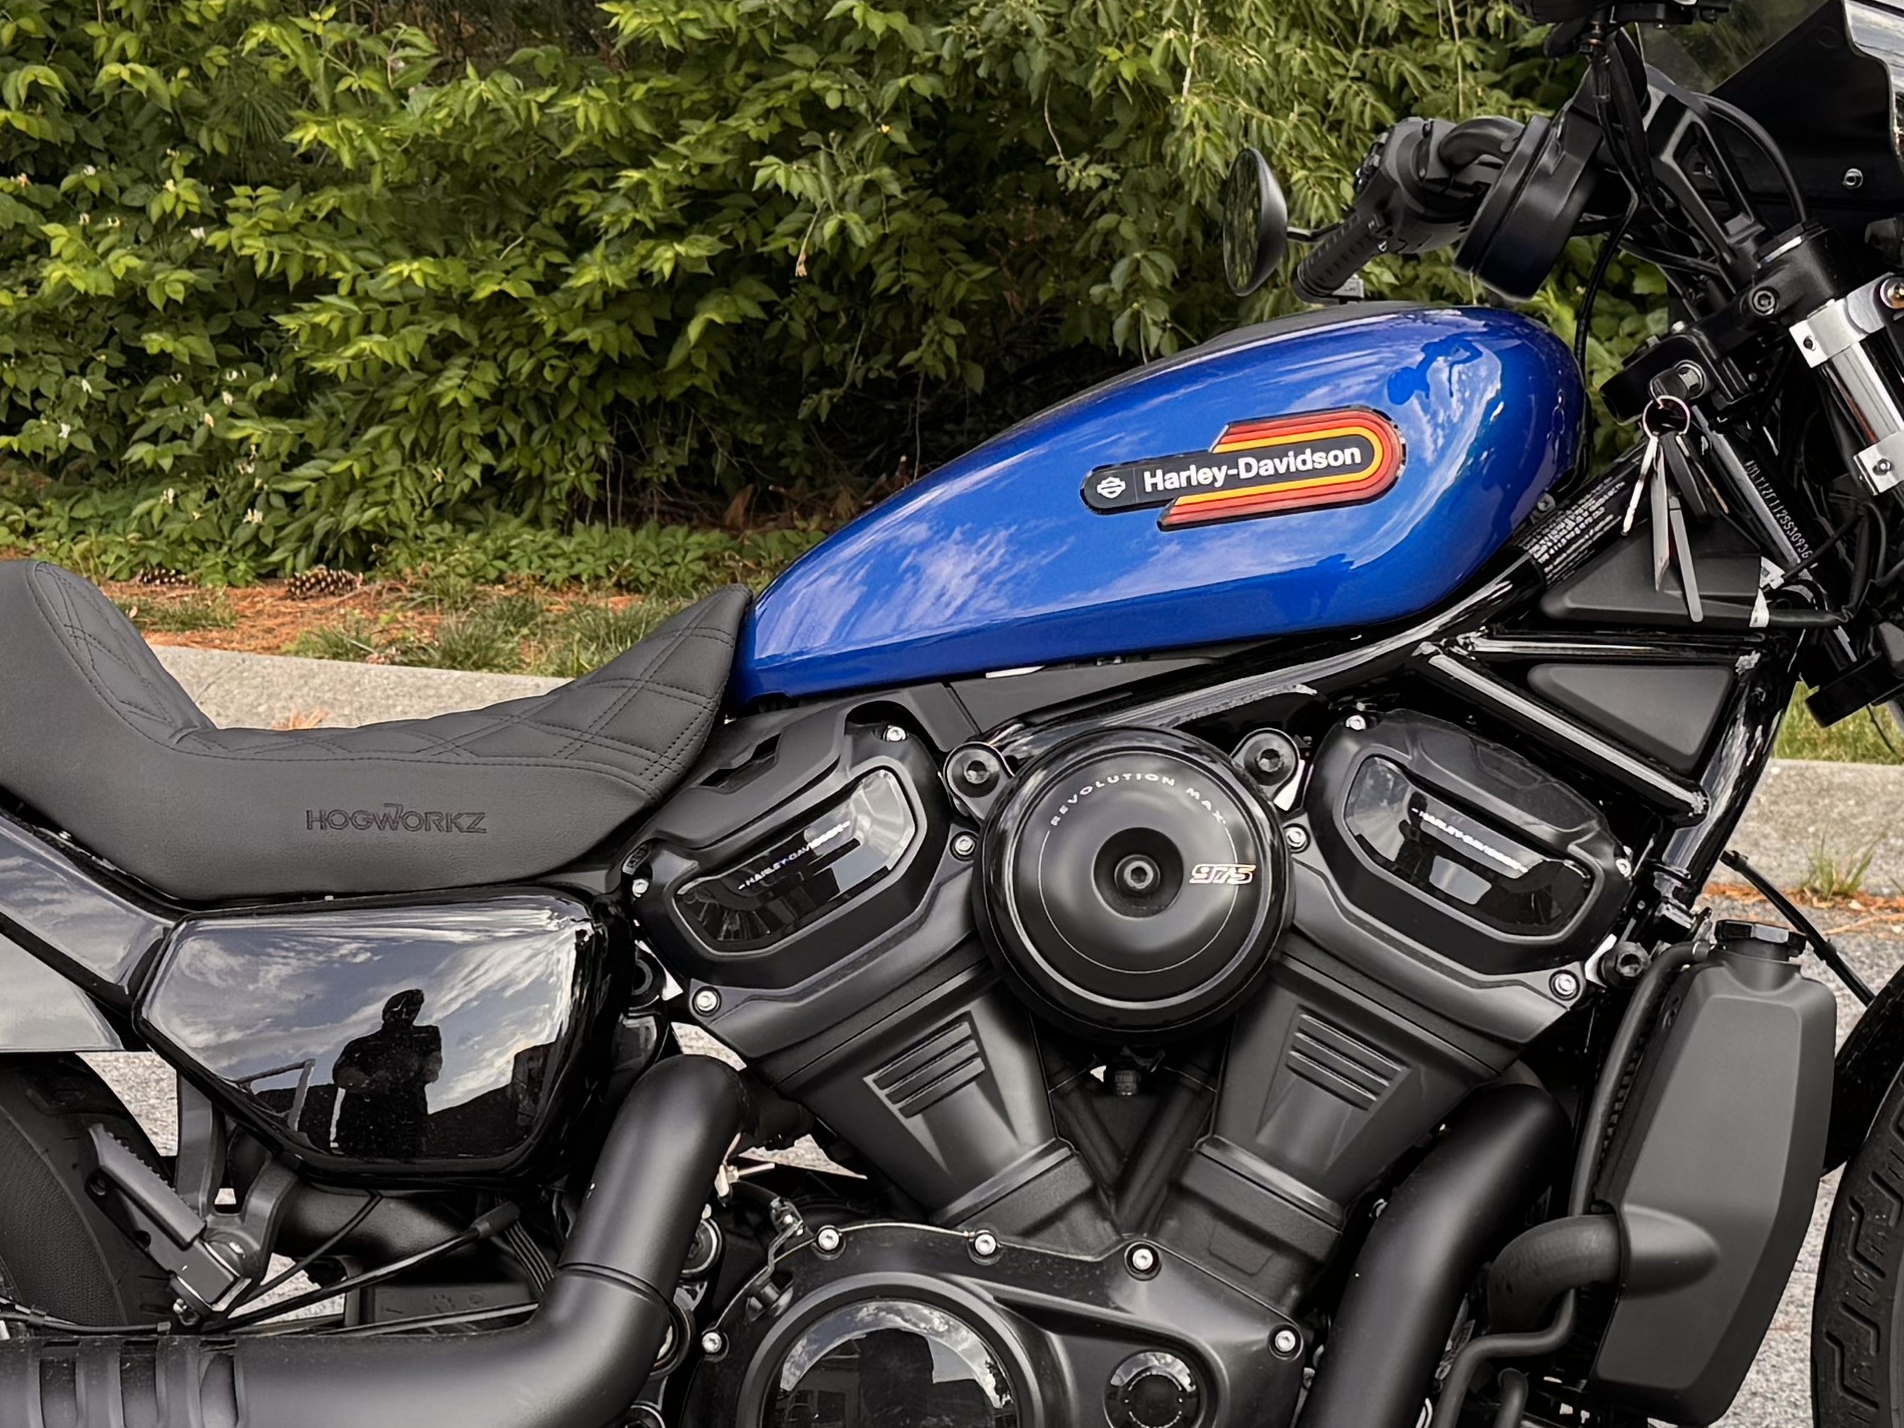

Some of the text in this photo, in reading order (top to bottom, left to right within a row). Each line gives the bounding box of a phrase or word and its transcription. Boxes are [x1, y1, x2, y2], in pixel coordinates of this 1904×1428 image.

[1144, 445, 1361, 493] Harley-Davidson
[305, 801, 488, 834] HOGWORKZ
[1050, 772, 1227, 827] REVOLUTION MAX
